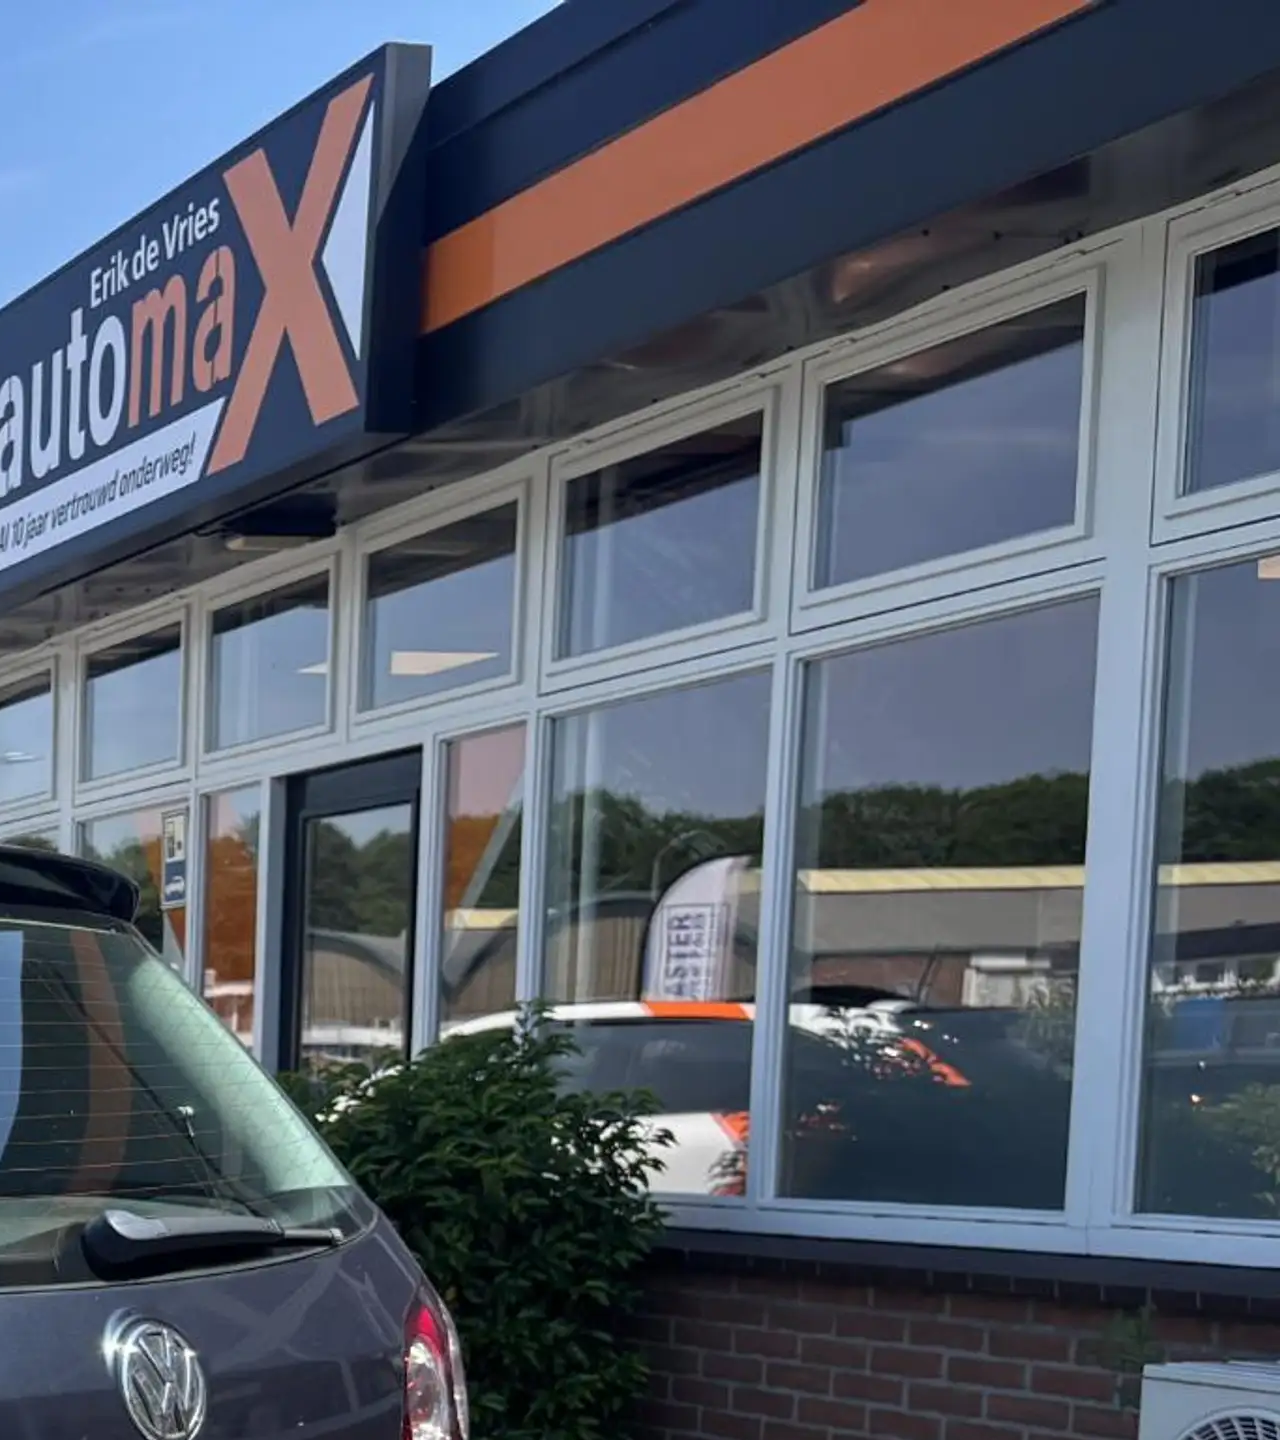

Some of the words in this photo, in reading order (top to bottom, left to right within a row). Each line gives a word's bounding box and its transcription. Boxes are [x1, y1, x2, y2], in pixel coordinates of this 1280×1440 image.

[89, 257, 130, 308] Erik
[132, 241, 159, 279] de
[161, 197, 220, 262] Vries
[50, 468, 119, 532] vertrouwd
